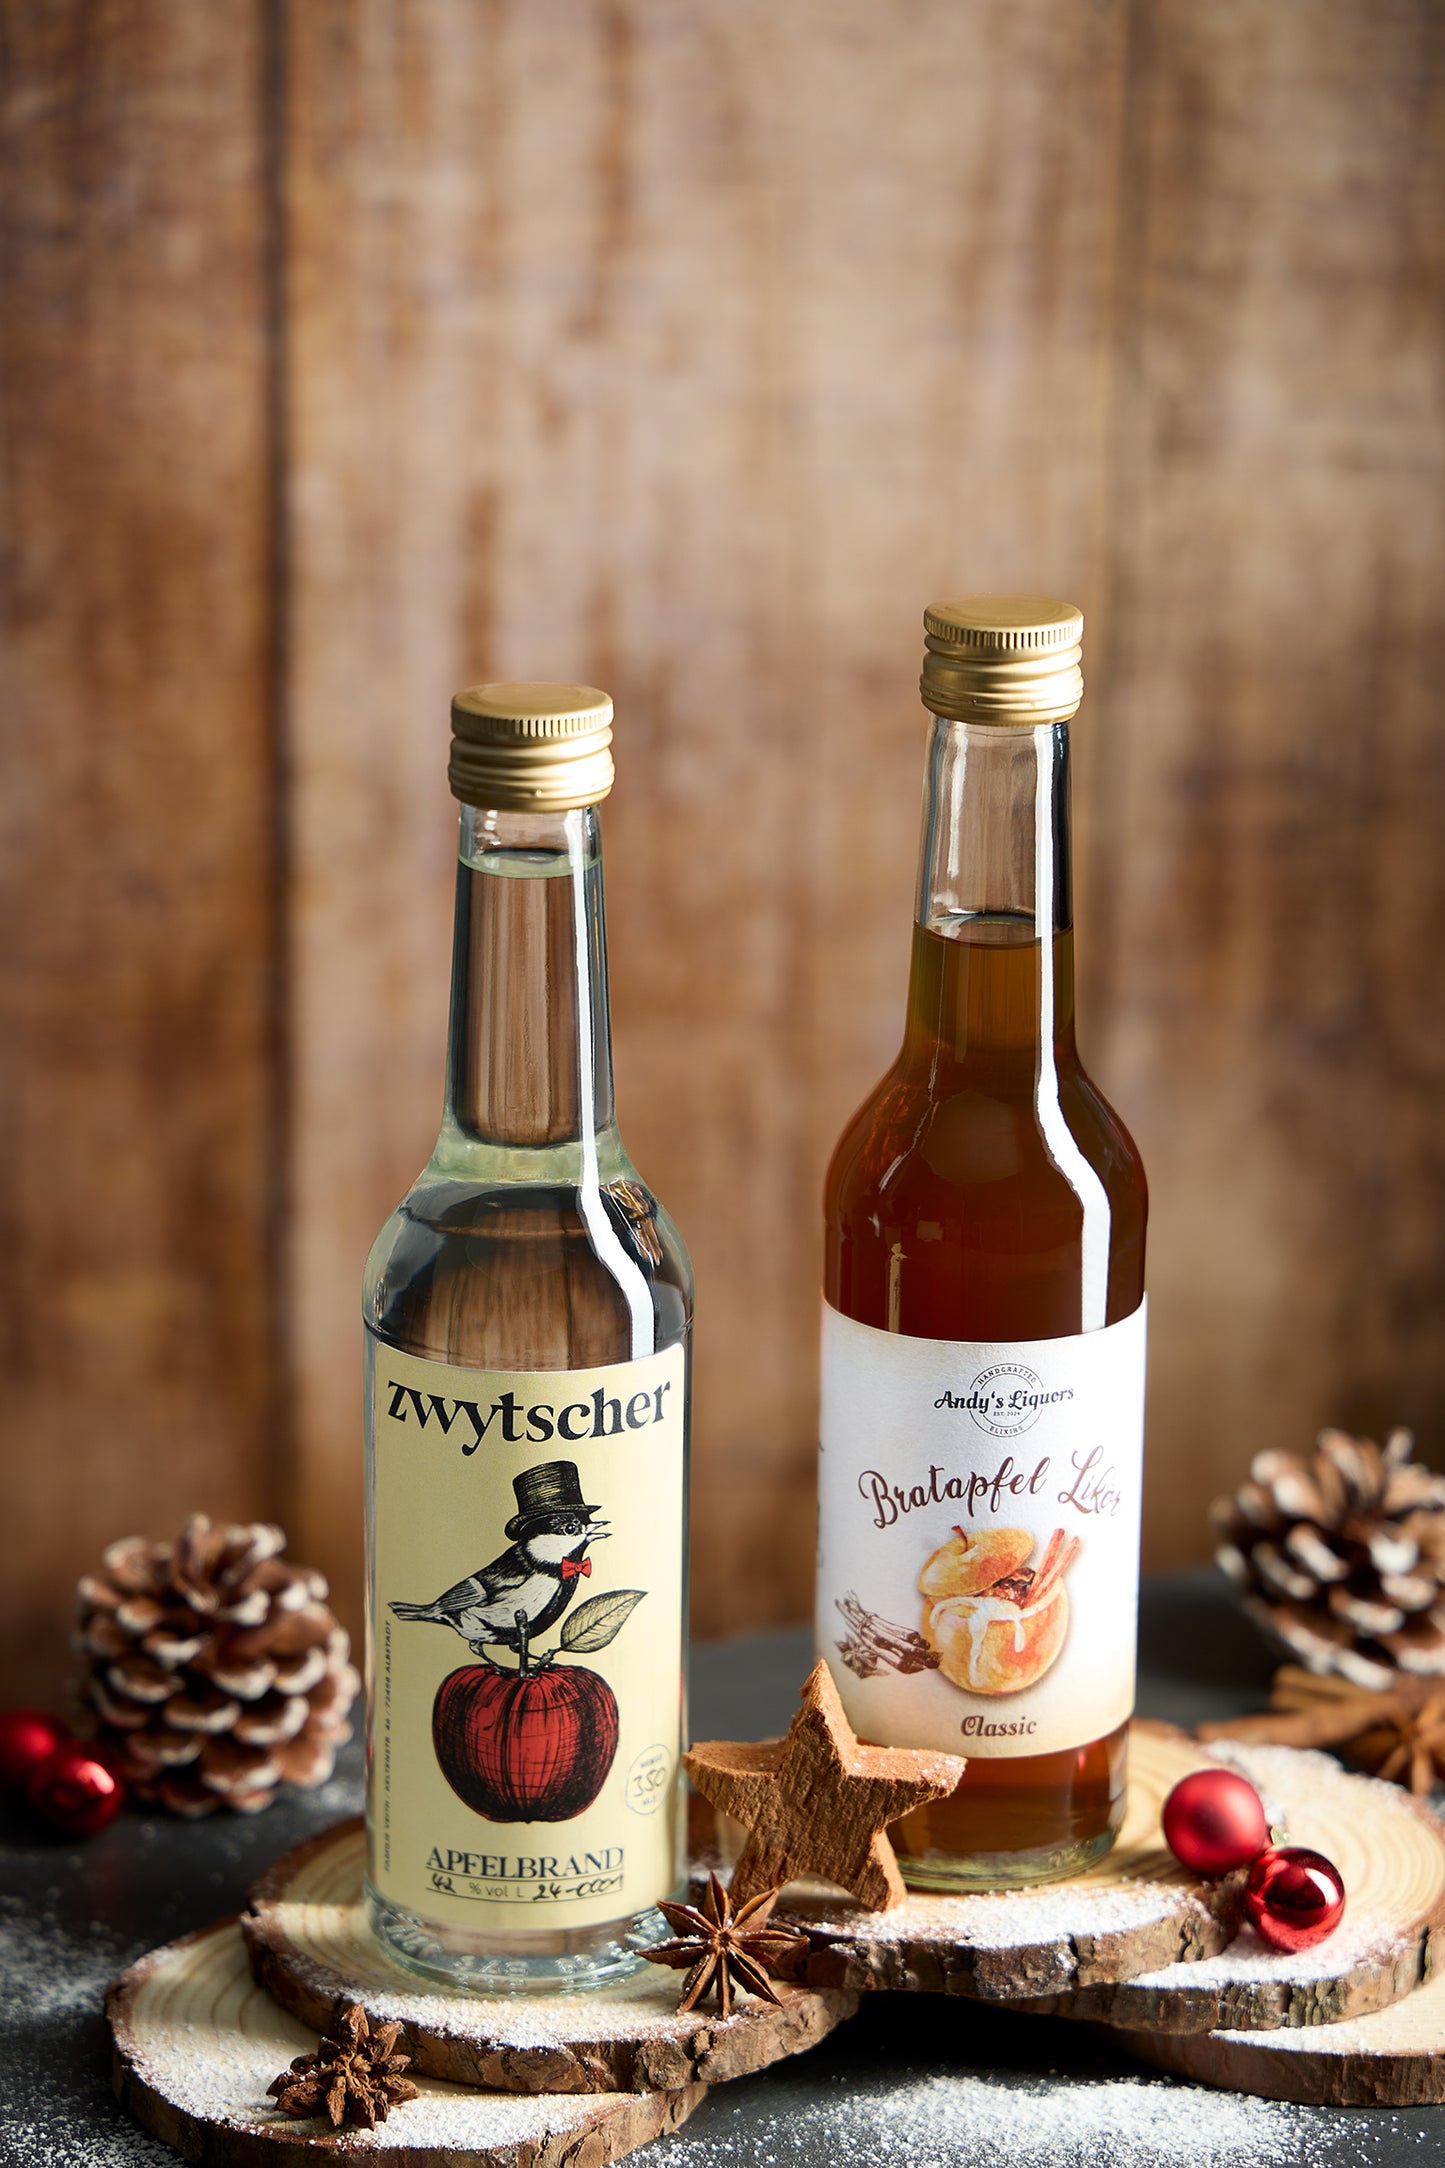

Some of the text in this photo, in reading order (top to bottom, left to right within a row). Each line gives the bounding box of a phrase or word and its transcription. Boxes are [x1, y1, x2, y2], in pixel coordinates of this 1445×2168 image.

[977, 1366, 1037, 1385] HANDCRAFTED
[1007, 1388, 1075, 1411] Liquors
[387, 1380, 671, 1457] zwytscher
[989, 1425, 1024, 1435] ELIXIRS
[858, 1455, 1051, 1530] Bratapfel
[384, 1620, 392, 1674] ALBSTADT
[961, 1715, 1037, 1737] Classic
[426, 1845, 624, 1878] APFELBRAND
[432, 1873, 457, 1894] 42
[486, 1884, 508, 1897] vol
